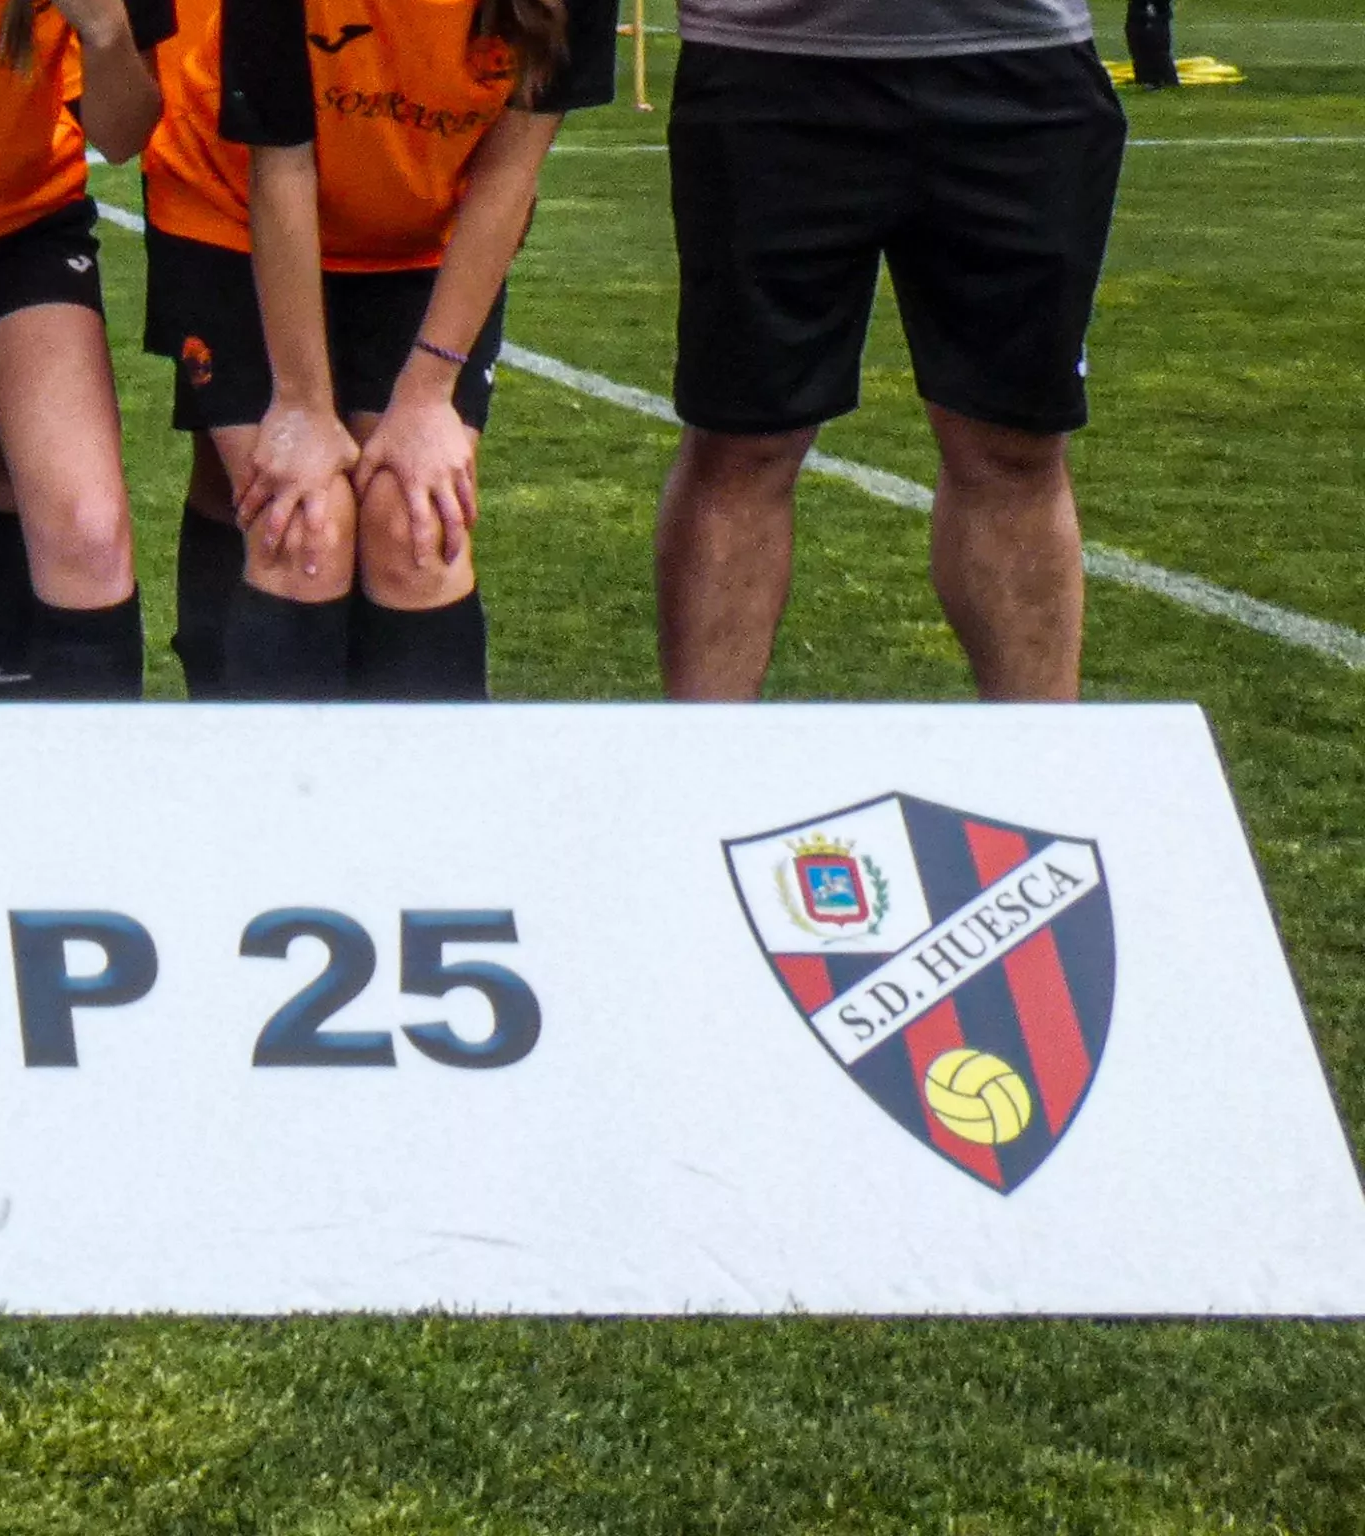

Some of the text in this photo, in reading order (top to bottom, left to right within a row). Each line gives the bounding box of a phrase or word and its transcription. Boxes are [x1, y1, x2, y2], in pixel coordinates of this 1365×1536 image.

[238, 906, 543, 1070] 25
[838, 861, 1085, 1042] S.D. HUESCA
